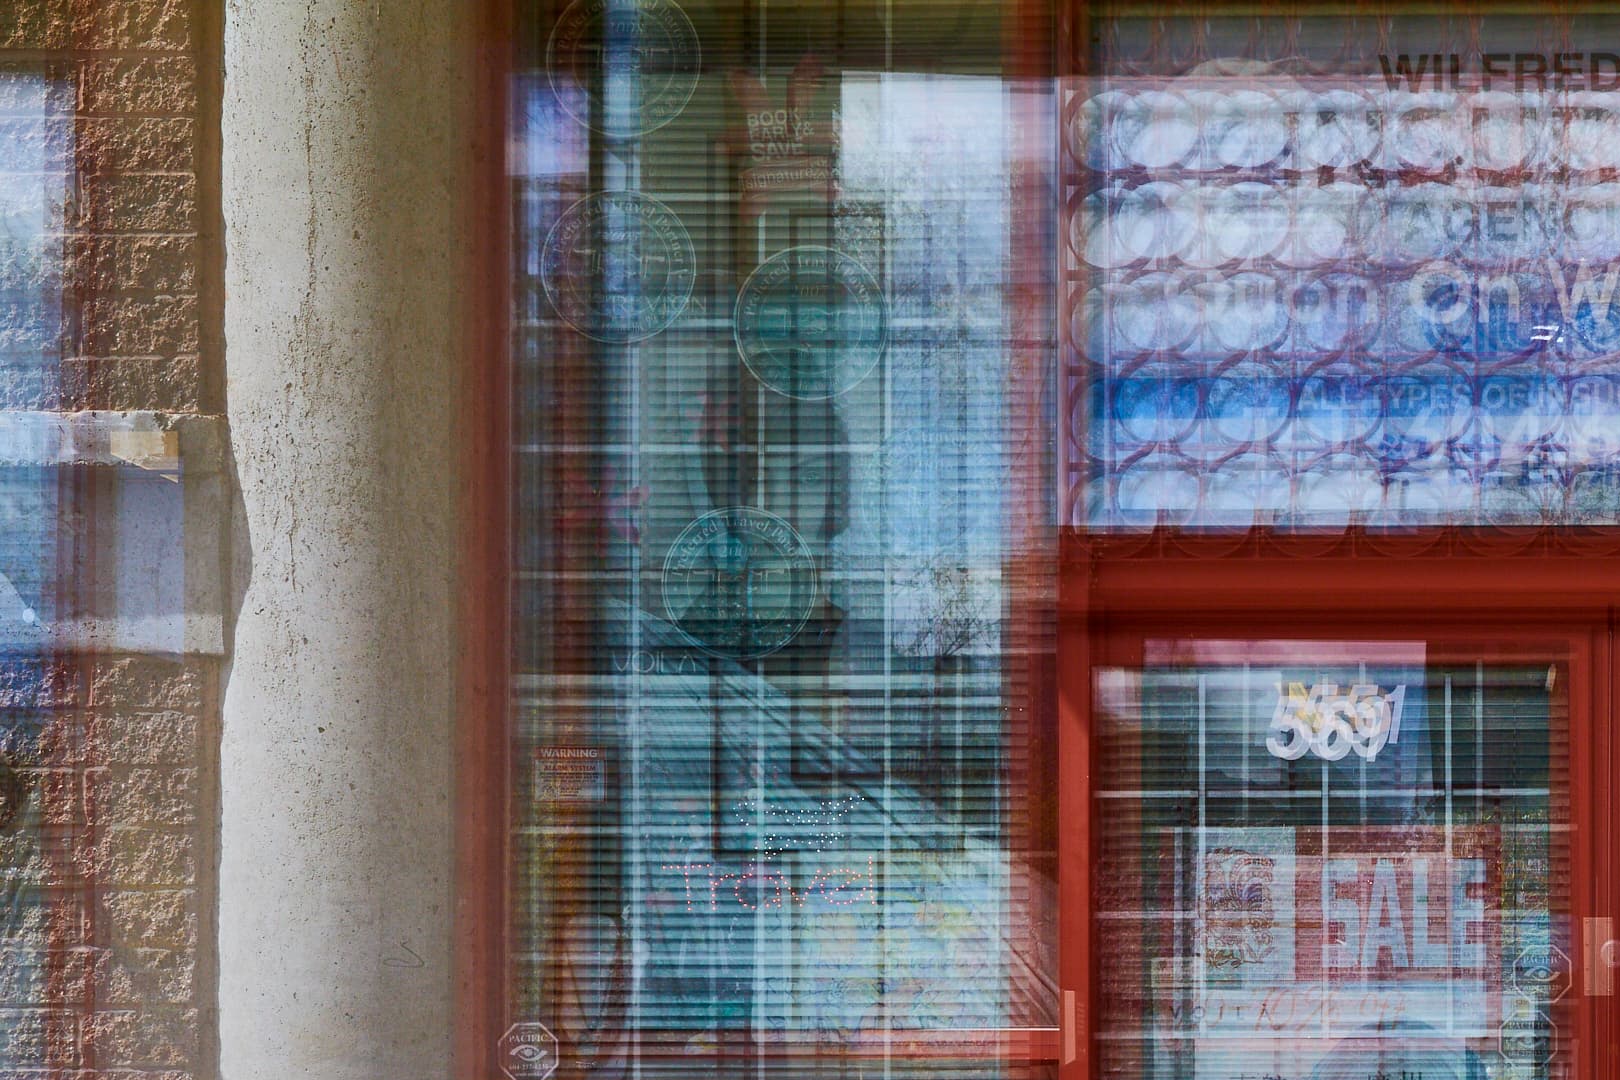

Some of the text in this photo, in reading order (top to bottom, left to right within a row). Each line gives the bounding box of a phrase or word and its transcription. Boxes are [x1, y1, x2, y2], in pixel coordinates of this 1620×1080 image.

[1411, 260, 1521, 324] On
[540, 748, 598, 758] WARNING
[662, 856, 875, 911] Travel
[1321, 857, 1488, 968] SALE
[509, 1033, 549, 1043] PACIFIC
